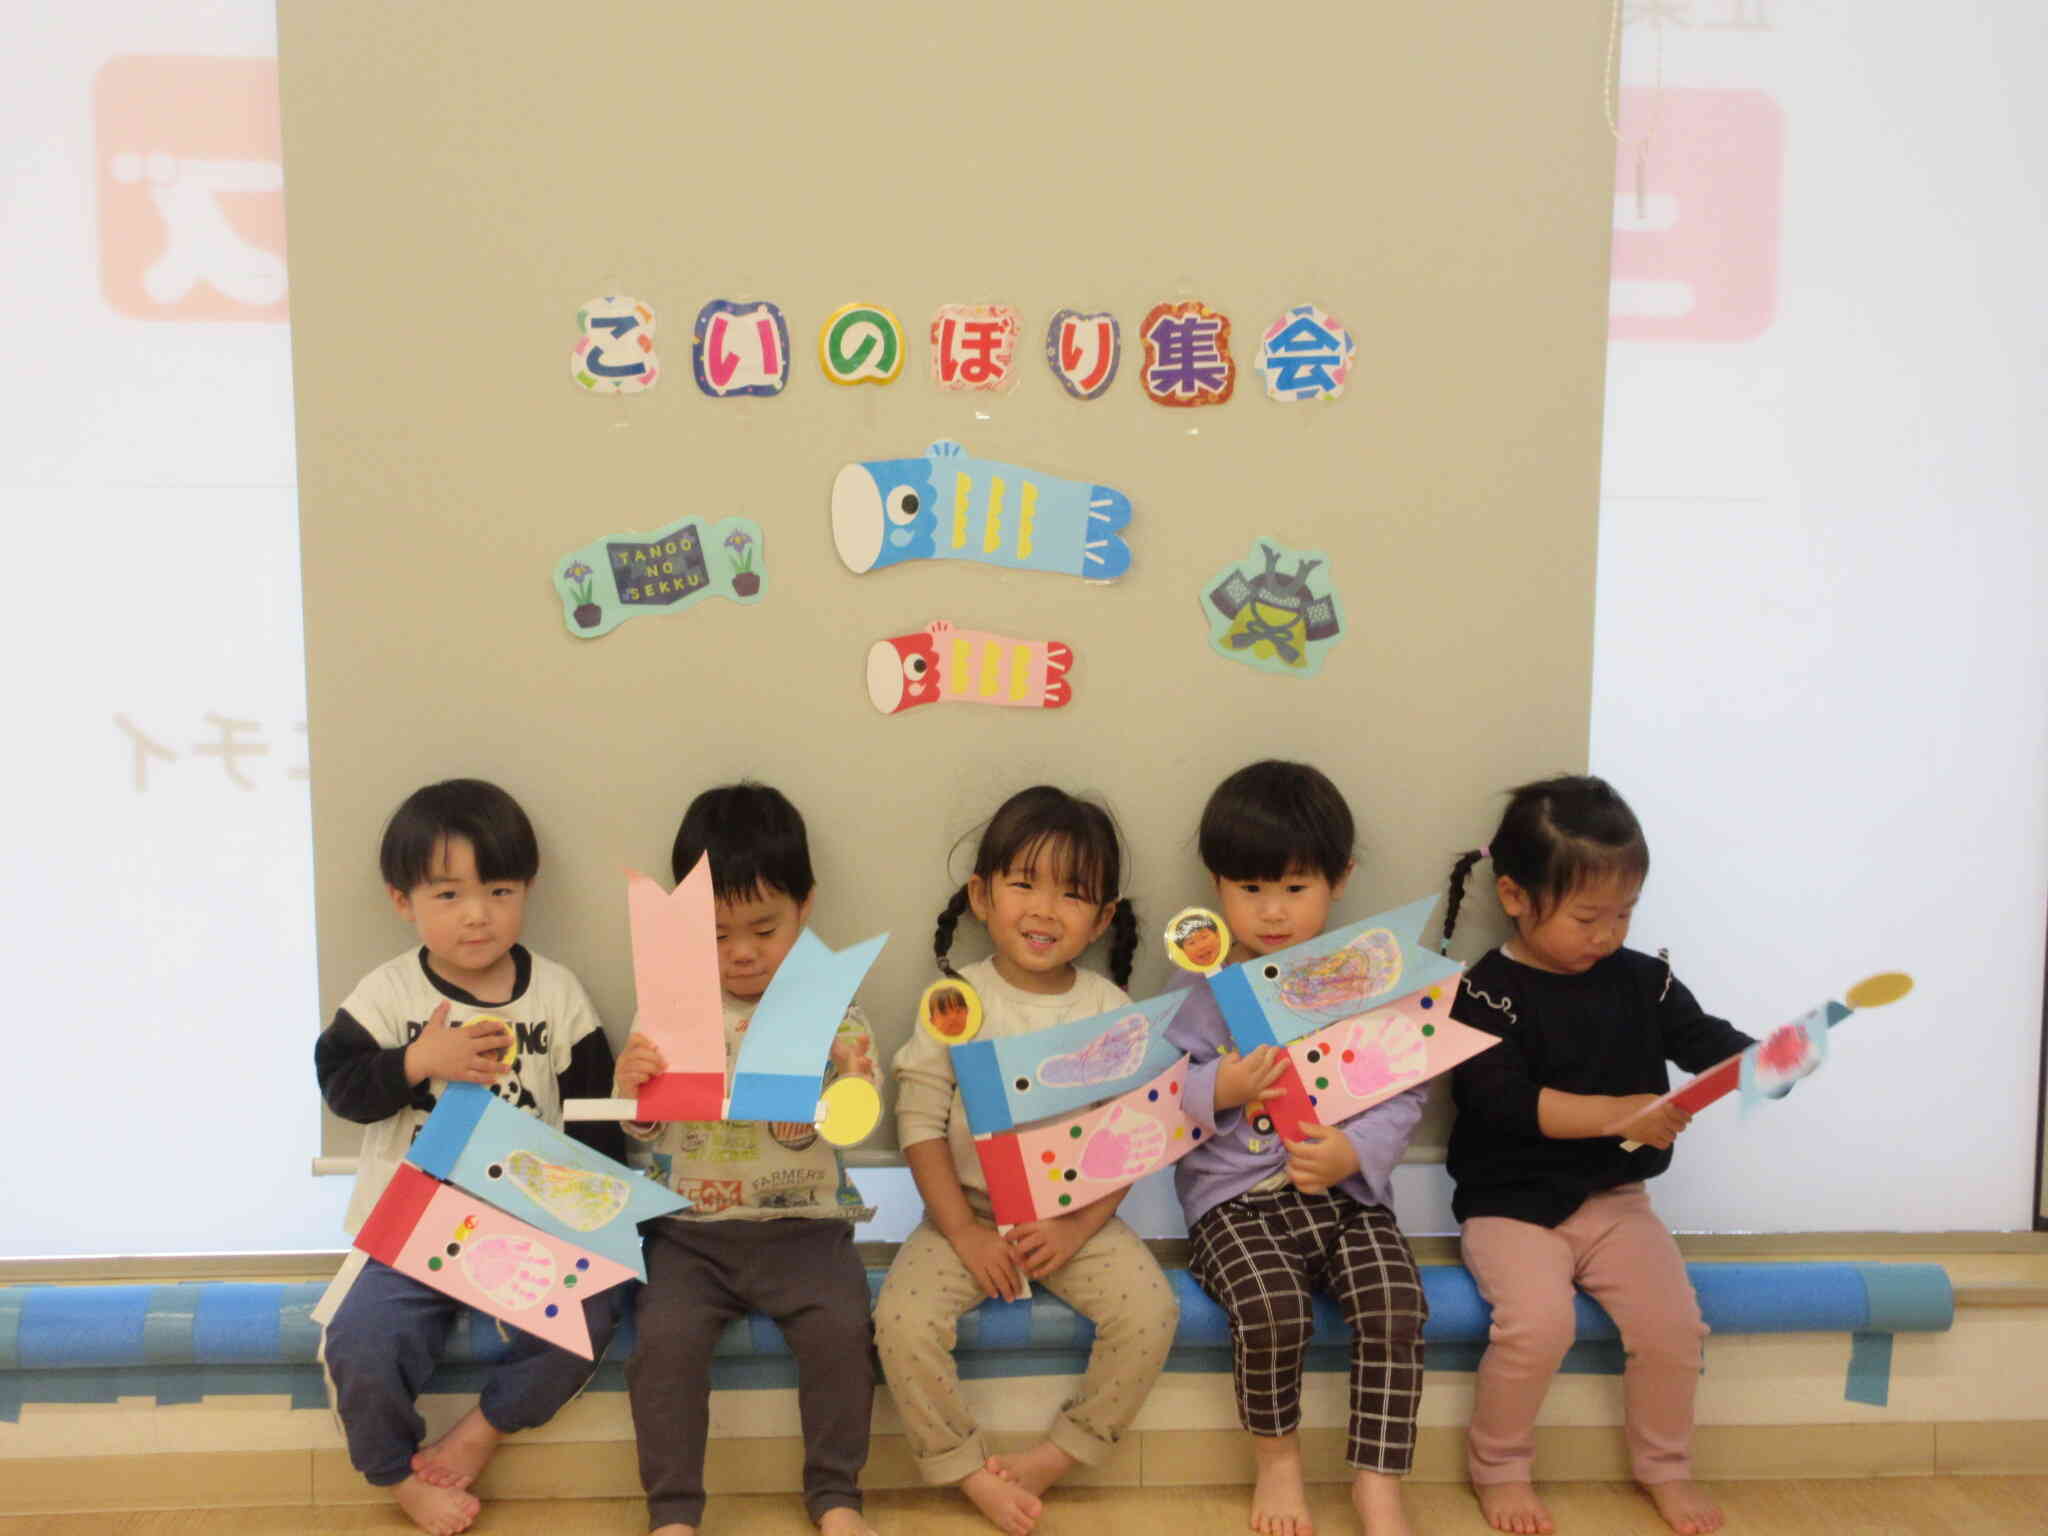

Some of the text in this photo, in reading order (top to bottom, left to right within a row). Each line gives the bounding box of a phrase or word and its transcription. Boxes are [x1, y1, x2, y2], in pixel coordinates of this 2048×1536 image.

[586, 309, 1341, 393] こいのぼり集会
[618, 540, 692, 565] TANGO
[646, 563, 673, 577] NO
[630, 576, 699, 600] SEKKU
